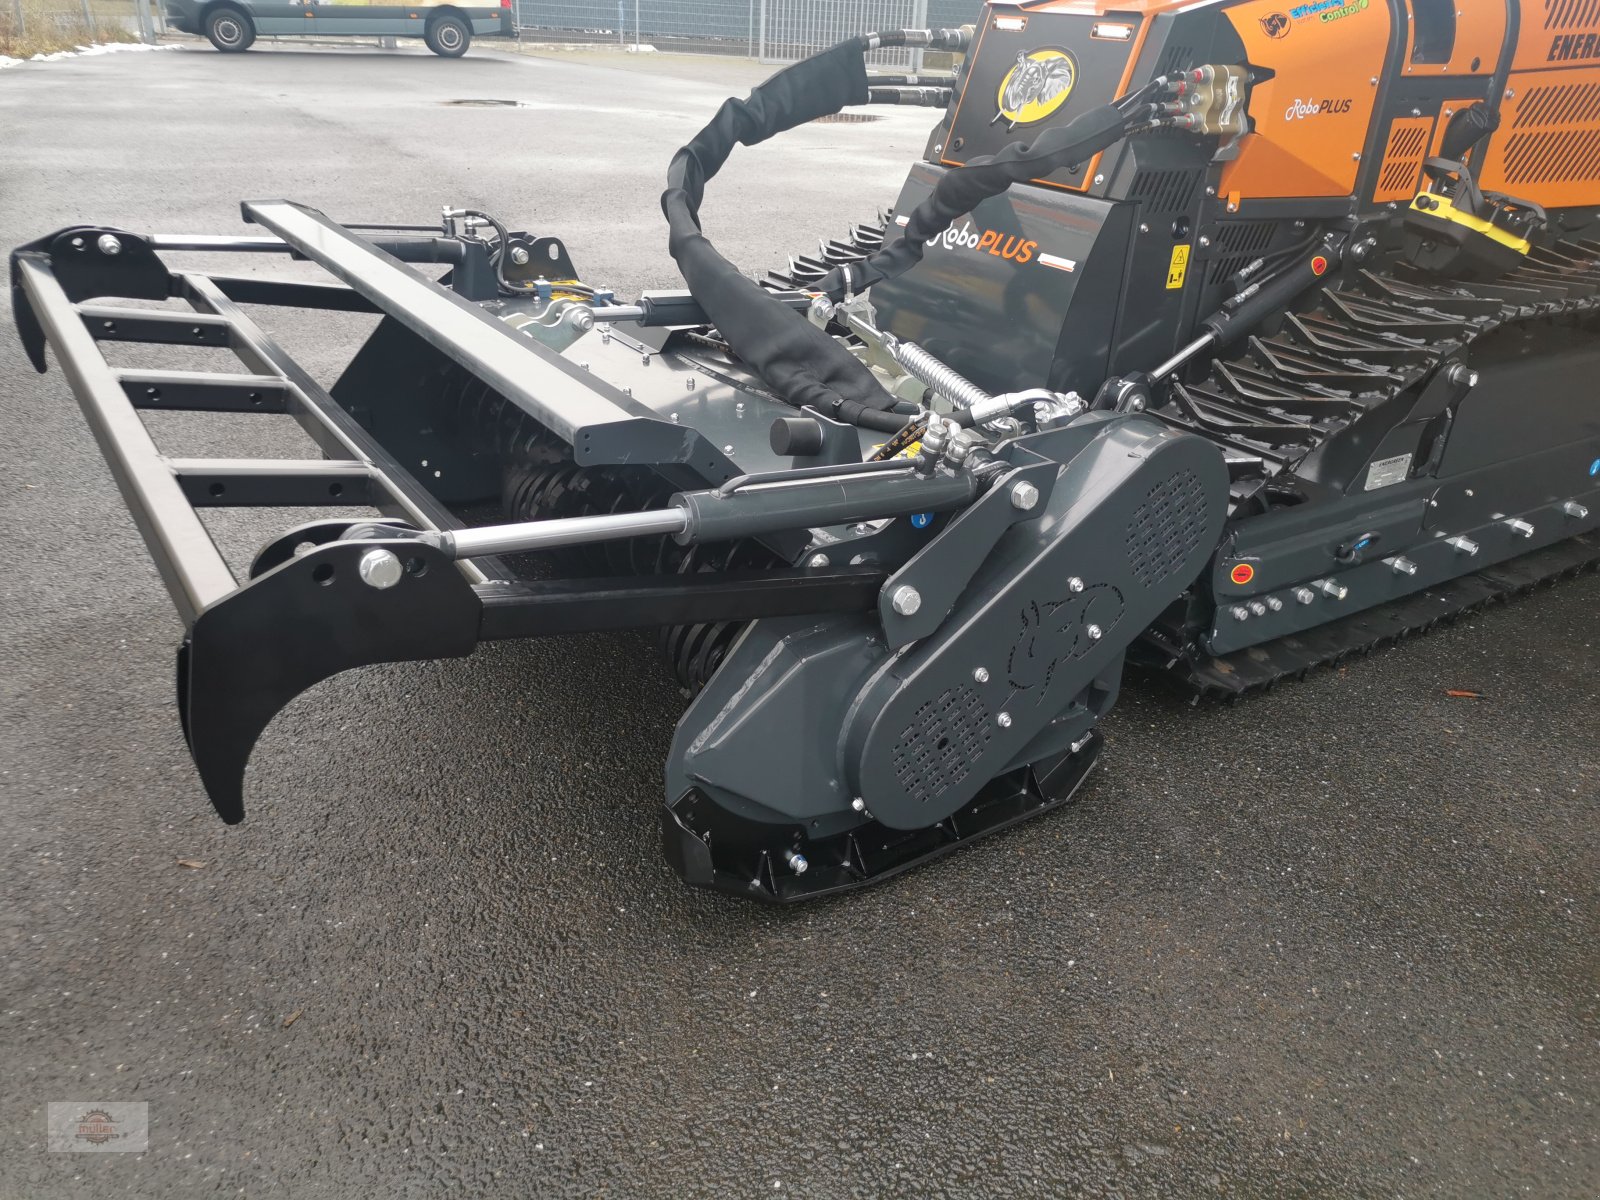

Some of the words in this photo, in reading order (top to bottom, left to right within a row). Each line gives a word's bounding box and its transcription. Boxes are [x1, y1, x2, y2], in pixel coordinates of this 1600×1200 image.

[1290, 0, 1344, 19] Efficiency
[1320, 3, 1360, 22] Control
[1285, 97, 1352, 120] RoboPLUS
